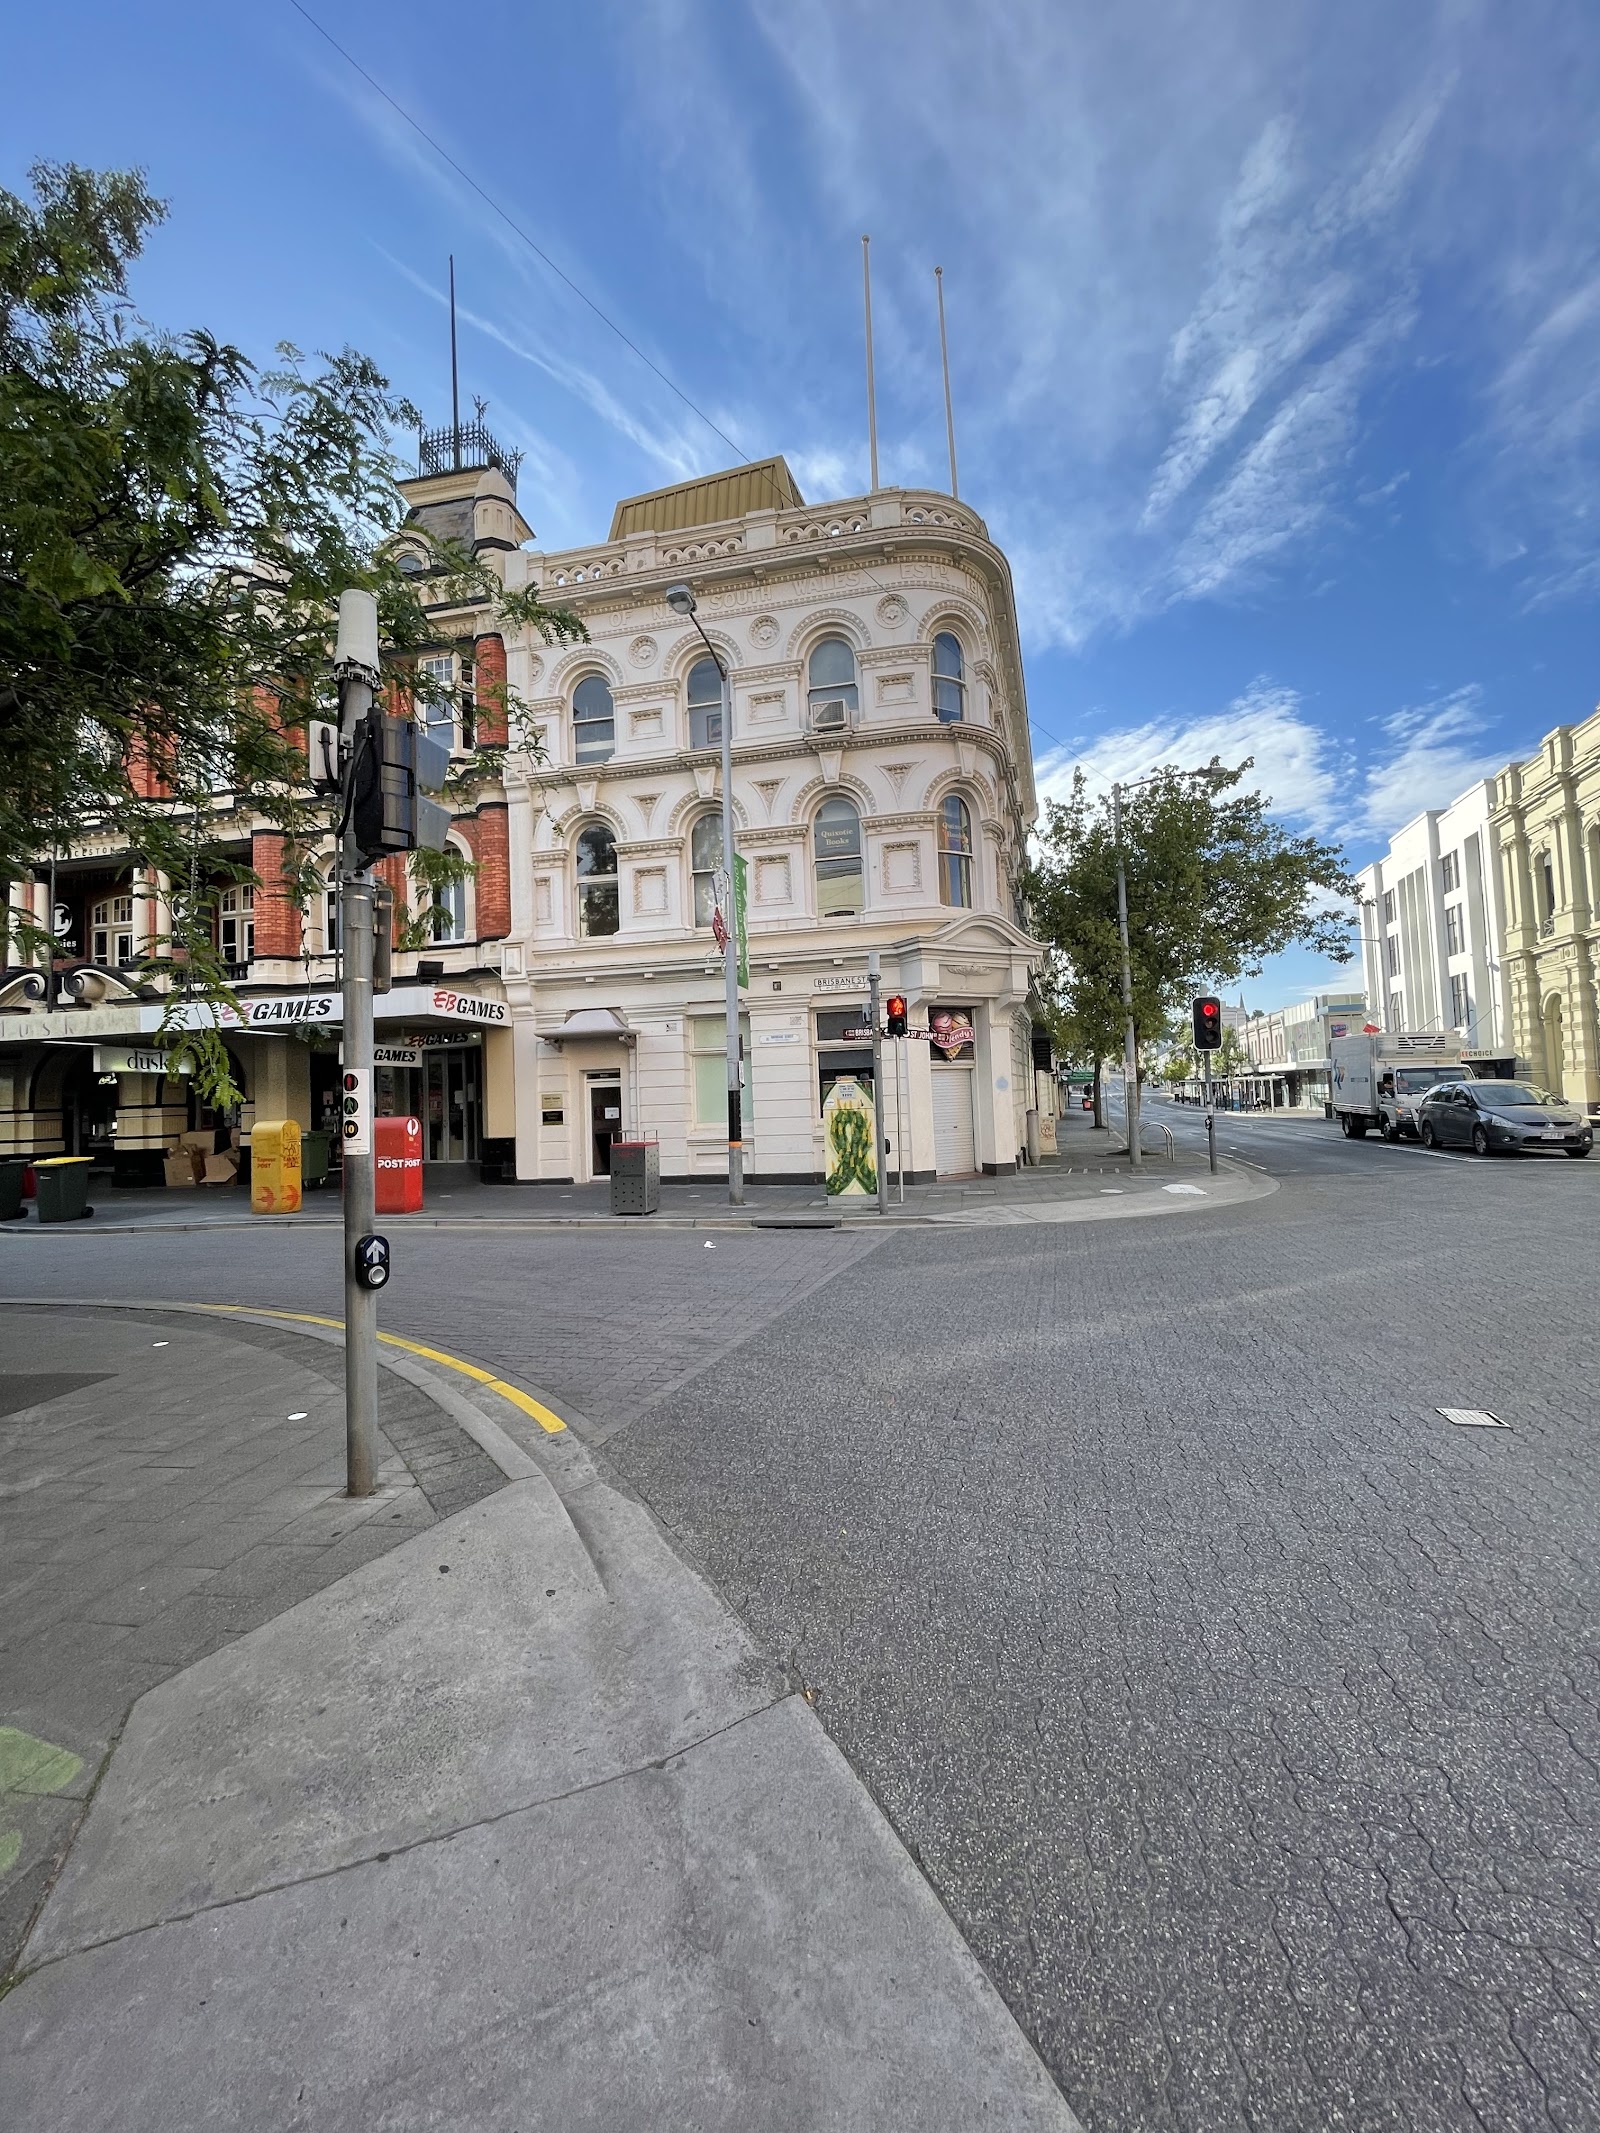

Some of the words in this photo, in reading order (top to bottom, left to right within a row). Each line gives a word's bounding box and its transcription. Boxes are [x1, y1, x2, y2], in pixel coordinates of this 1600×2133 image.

[708, 587, 773, 611] SOUTH
[820, 829, 854, 839] Quixotic
[825, 837, 850, 846] Books
[817, 977, 855, 986] BRISBANE
[252, 998, 332, 1020] GAMES
[432, 991, 458, 1012] EB
[456, 998, 506, 1020] GAMES
[126, 1050, 169, 1071] dusk
[373, 1048, 418, 1063] GAMES
[377, 1159, 404, 1169] POST
[404, 1159, 421, 1168] POST
